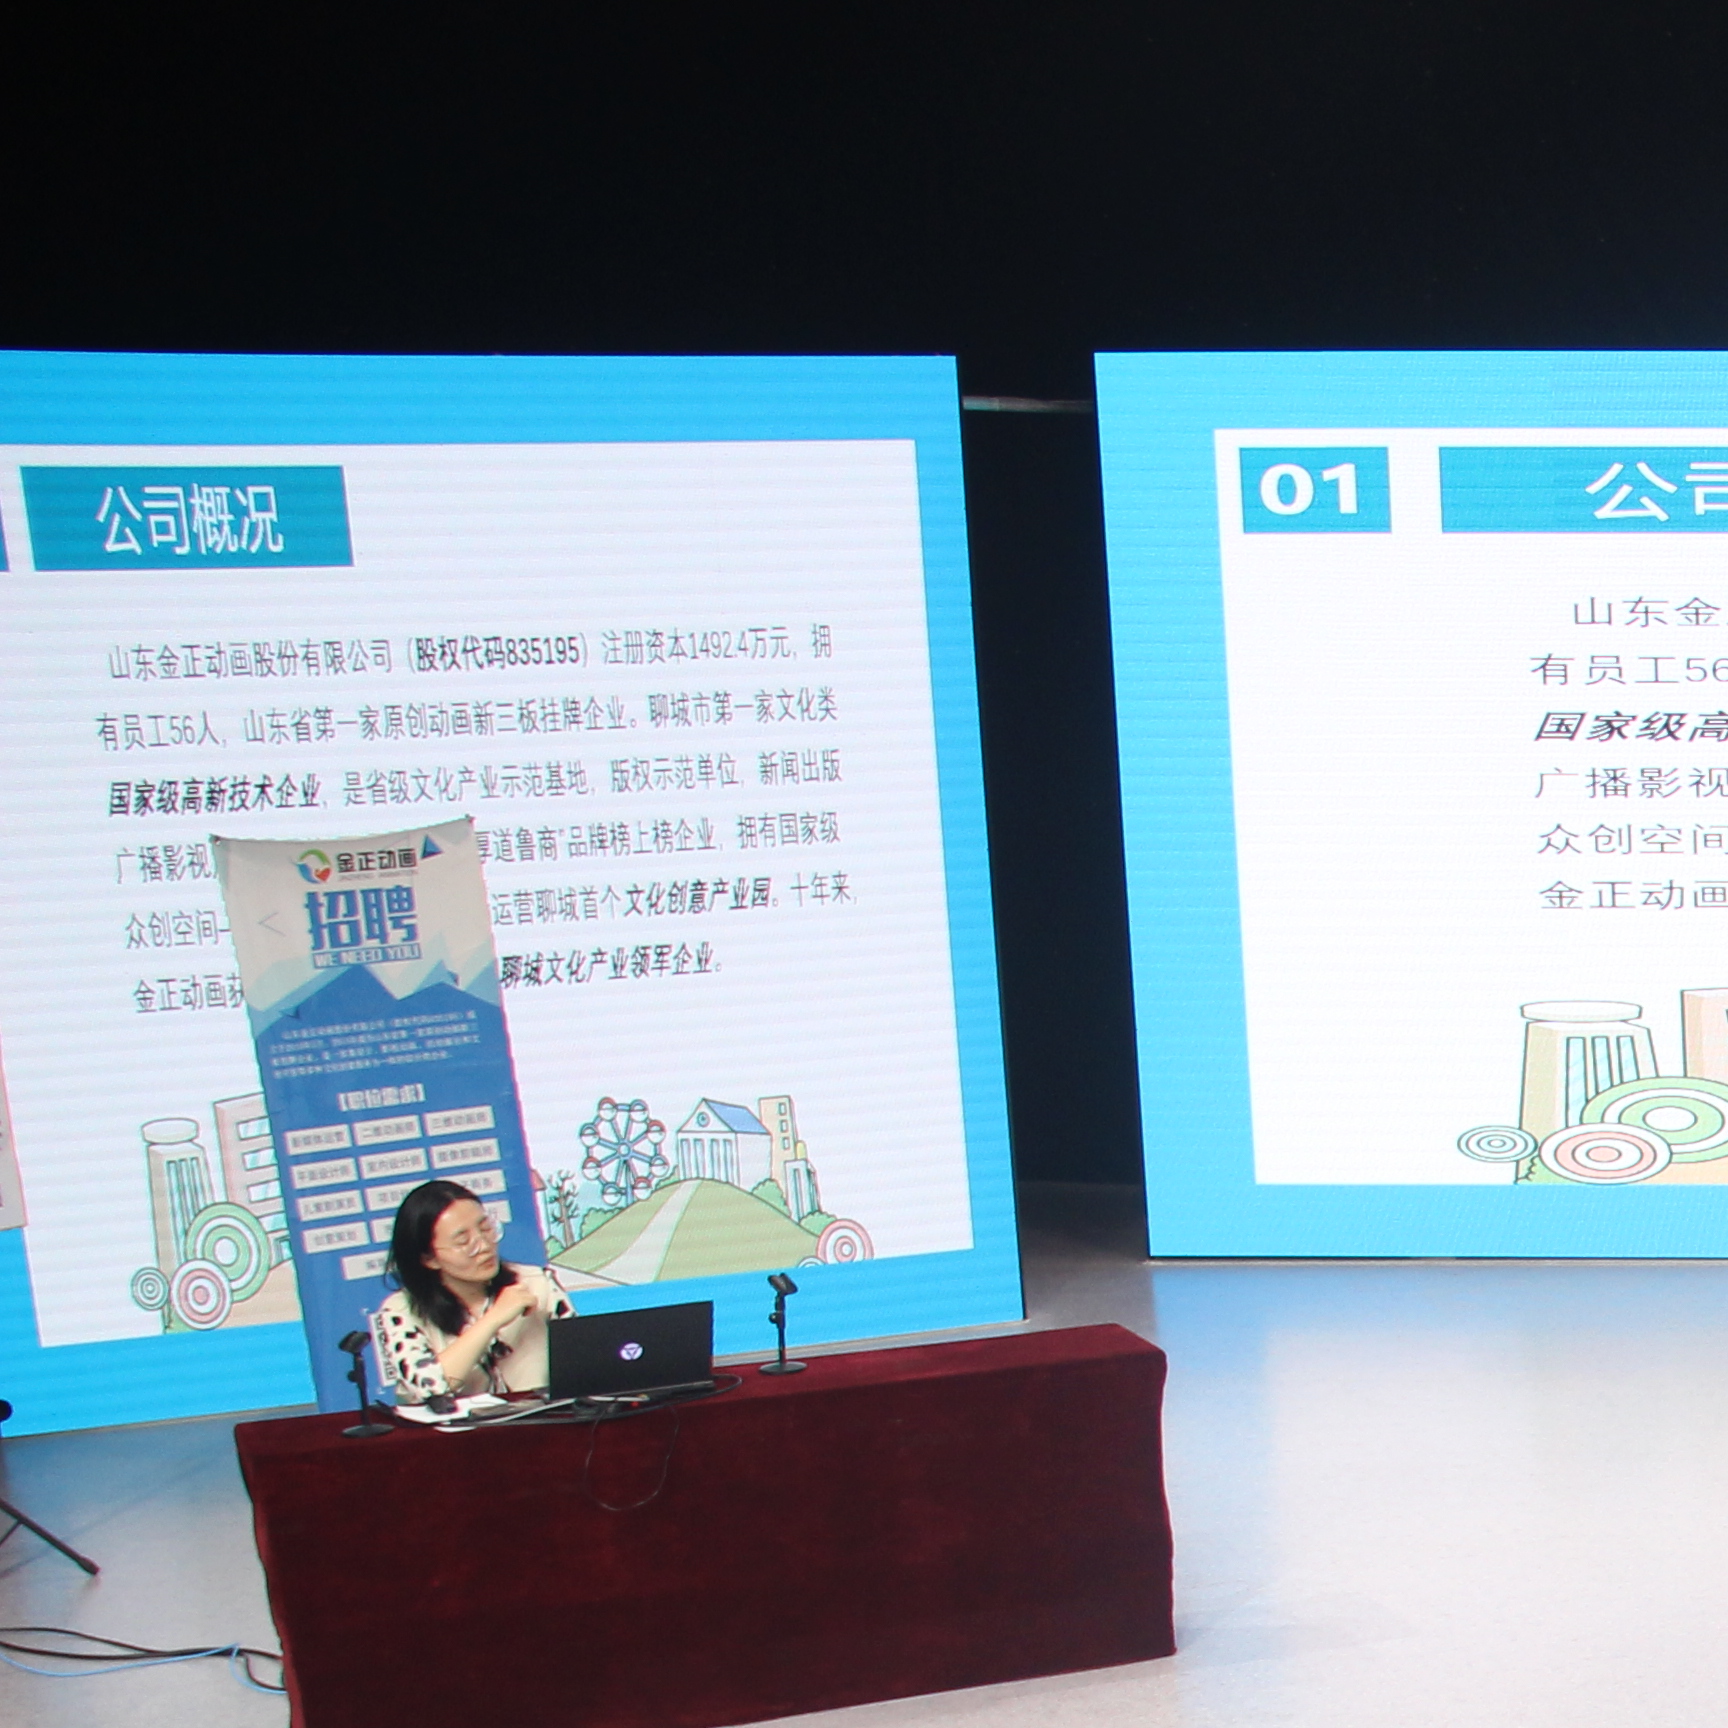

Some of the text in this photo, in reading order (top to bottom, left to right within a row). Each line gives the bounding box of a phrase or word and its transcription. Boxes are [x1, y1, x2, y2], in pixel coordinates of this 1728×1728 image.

[1258, 462, 1360, 517] 01
[95, 484, 284, 560] 公司概况
[336, 848, 418, 873] 金正动画
[303, 884, 420, 951] 招聘
